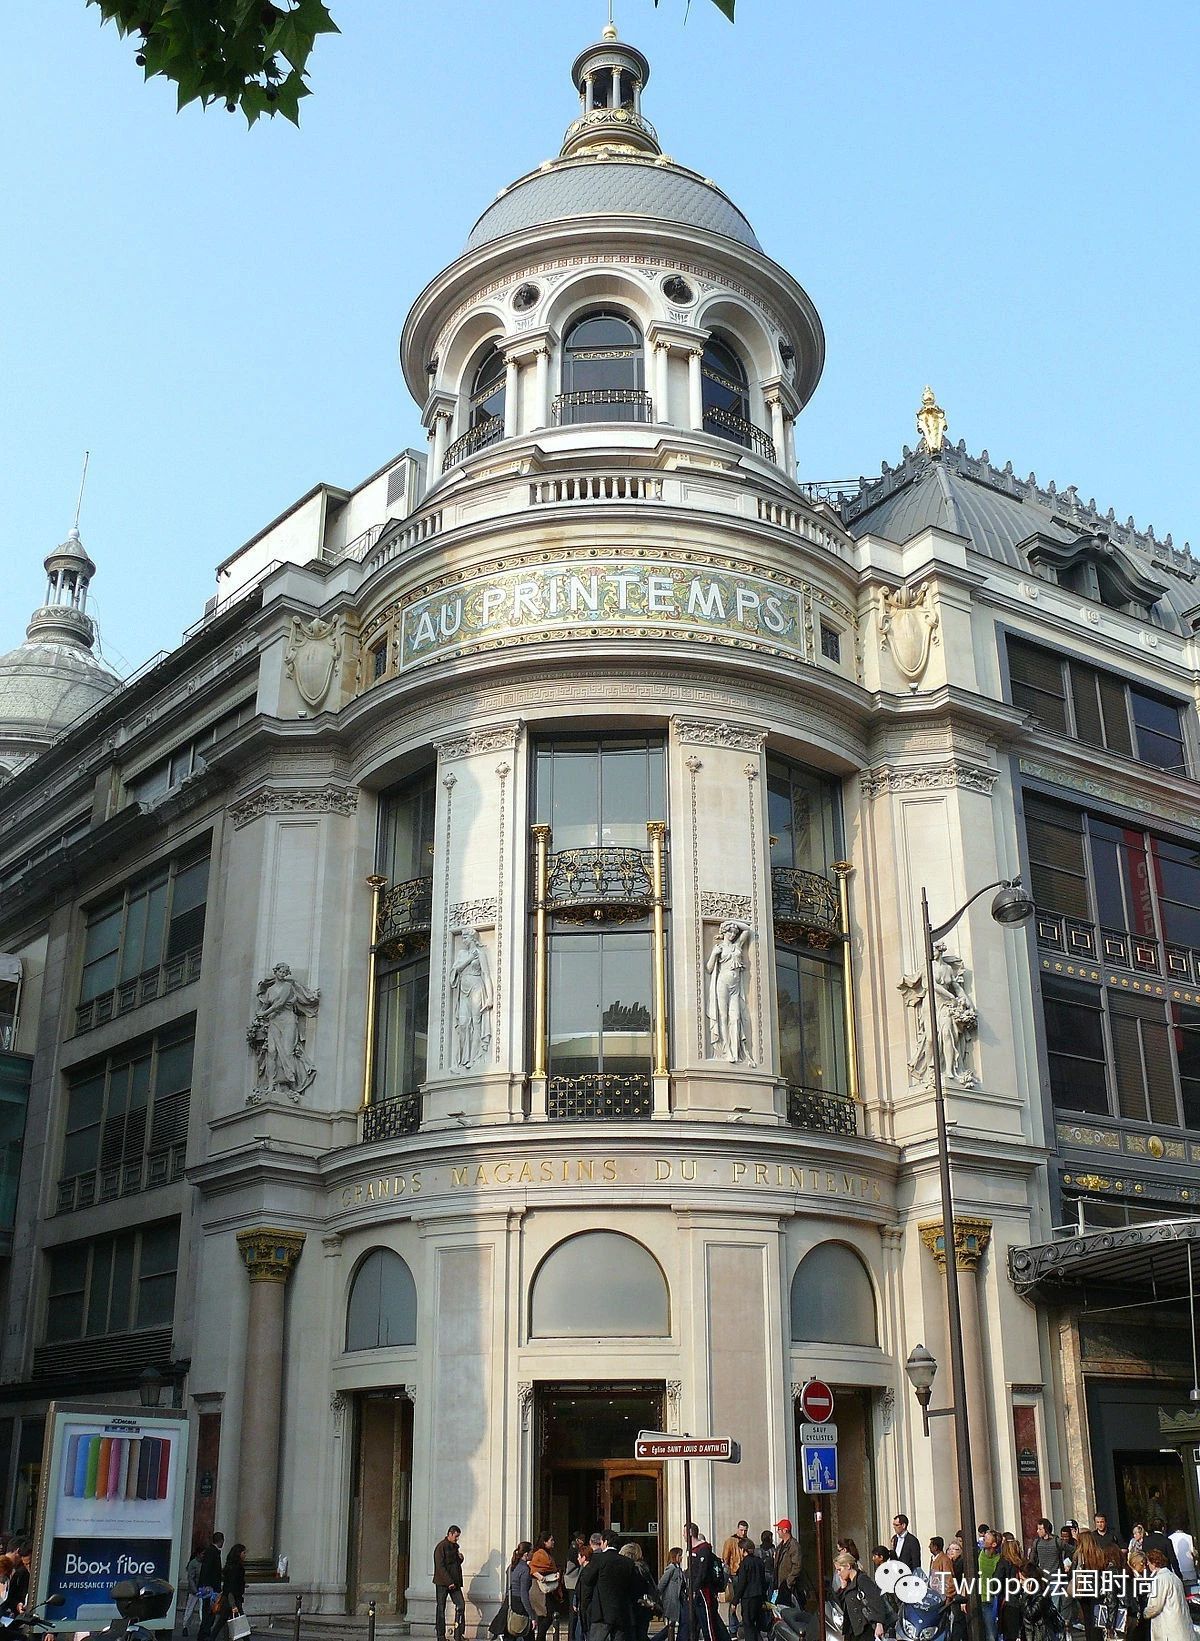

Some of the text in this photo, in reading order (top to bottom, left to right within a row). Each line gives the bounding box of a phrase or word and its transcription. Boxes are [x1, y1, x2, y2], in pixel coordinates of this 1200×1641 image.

[414, 575, 788, 650] AU PRINTEMPS
[342, 1159, 882, 1208] GRANDS MAGASINS DU PRINTEMPS
[812, 1426, 827, 1434] SAUF
[651, 1445, 665, 1456] Église
[667, 1445, 682, 1453] SAINT
[683, 1445, 698, 1453] LOUIS
[65, 1554, 156, 1575] Bbox fibre
[59, 1581, 68, 1589] LA
[68, 1581, 105, 1590] PUISSANCE
